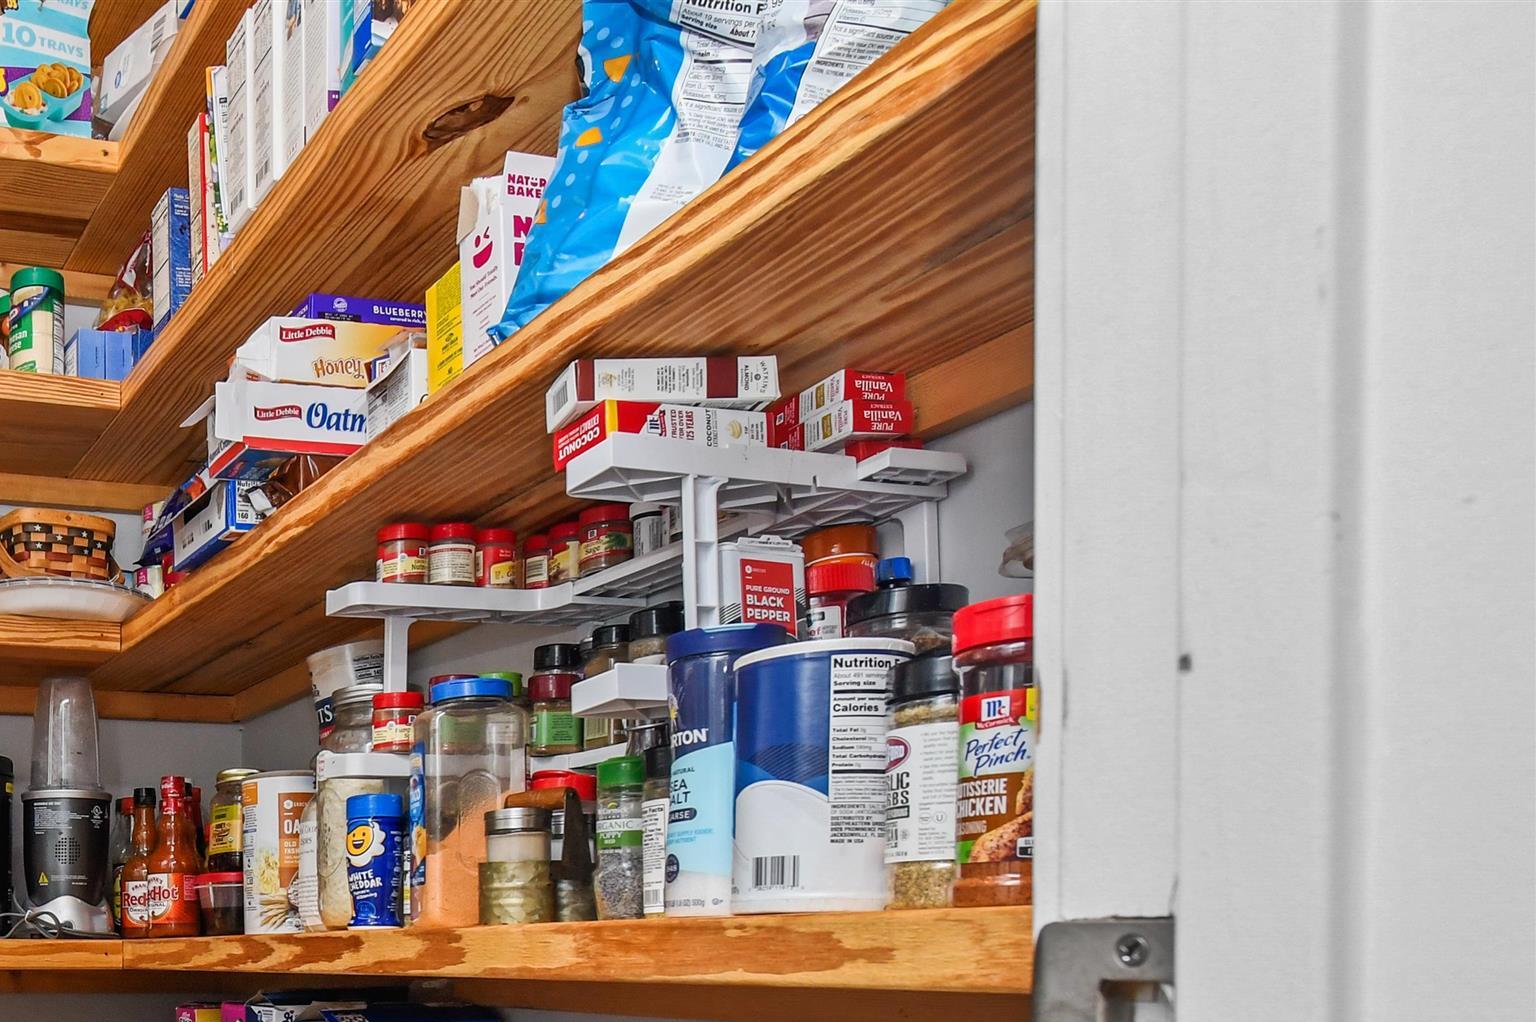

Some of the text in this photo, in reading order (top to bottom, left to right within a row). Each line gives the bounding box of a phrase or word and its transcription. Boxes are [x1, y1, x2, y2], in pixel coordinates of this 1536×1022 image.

[1, 22, 85, 59] 10 TRAYS
[281, 326, 334, 341] Little Debbie
[313, 357, 364, 379] Honey
[854, 379, 894, 393] Vanilla
[256, 405, 301, 419] Little Debbie
[863, 410, 902, 422] Vanilla
[871, 422, 894, 431] PURE
[558, 426, 601, 460] COCONUT
[745, 584, 790, 595] PURE GROUND
[745, 594, 784, 608] BLACK
[746, 607, 791, 622] PEPPER
[833, 656, 892, 669] Nutrition
[832, 703, 879, 712] Calories
[670, 727, 709, 748] RTON
[964, 728, 1029, 762] Perfect
[973, 741, 1030, 777] Pinch
[669, 809, 690, 820] ARSE
[284, 819, 301, 835] OA
